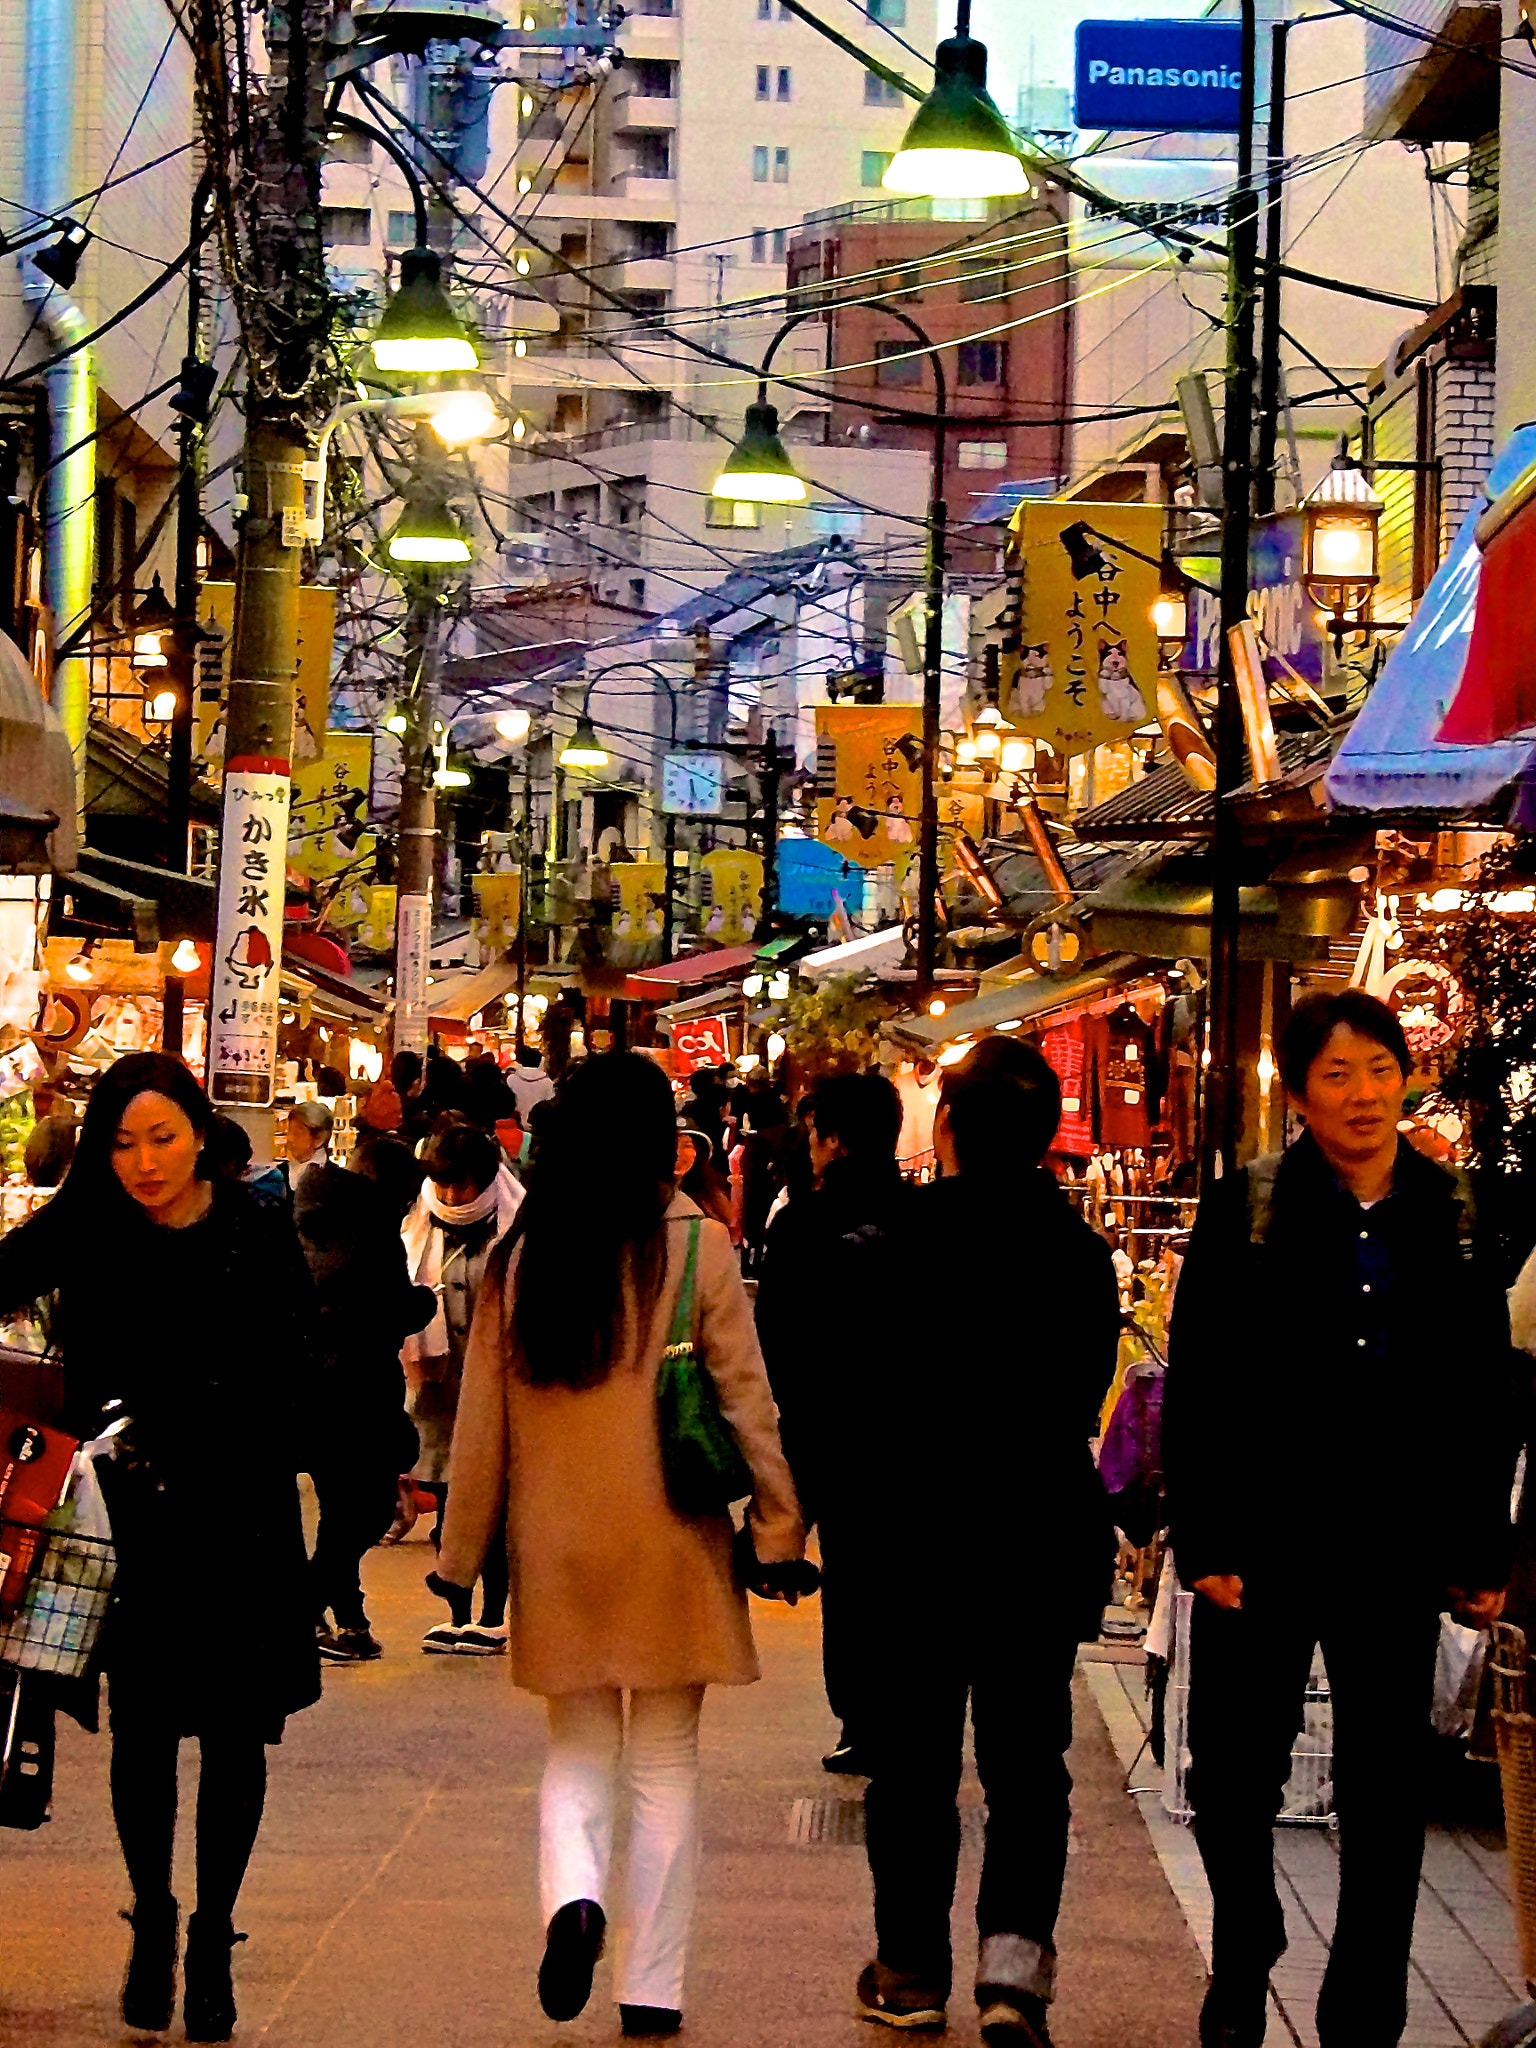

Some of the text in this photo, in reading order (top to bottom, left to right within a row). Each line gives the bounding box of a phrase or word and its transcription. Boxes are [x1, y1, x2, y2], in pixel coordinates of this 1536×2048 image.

[1089, 60, 1242, 90] Panasonic
[1064, 591, 1087, 707] ようこそ
[331, 763, 350, 806] 谷中
[236, 813, 272, 917] かき氷
